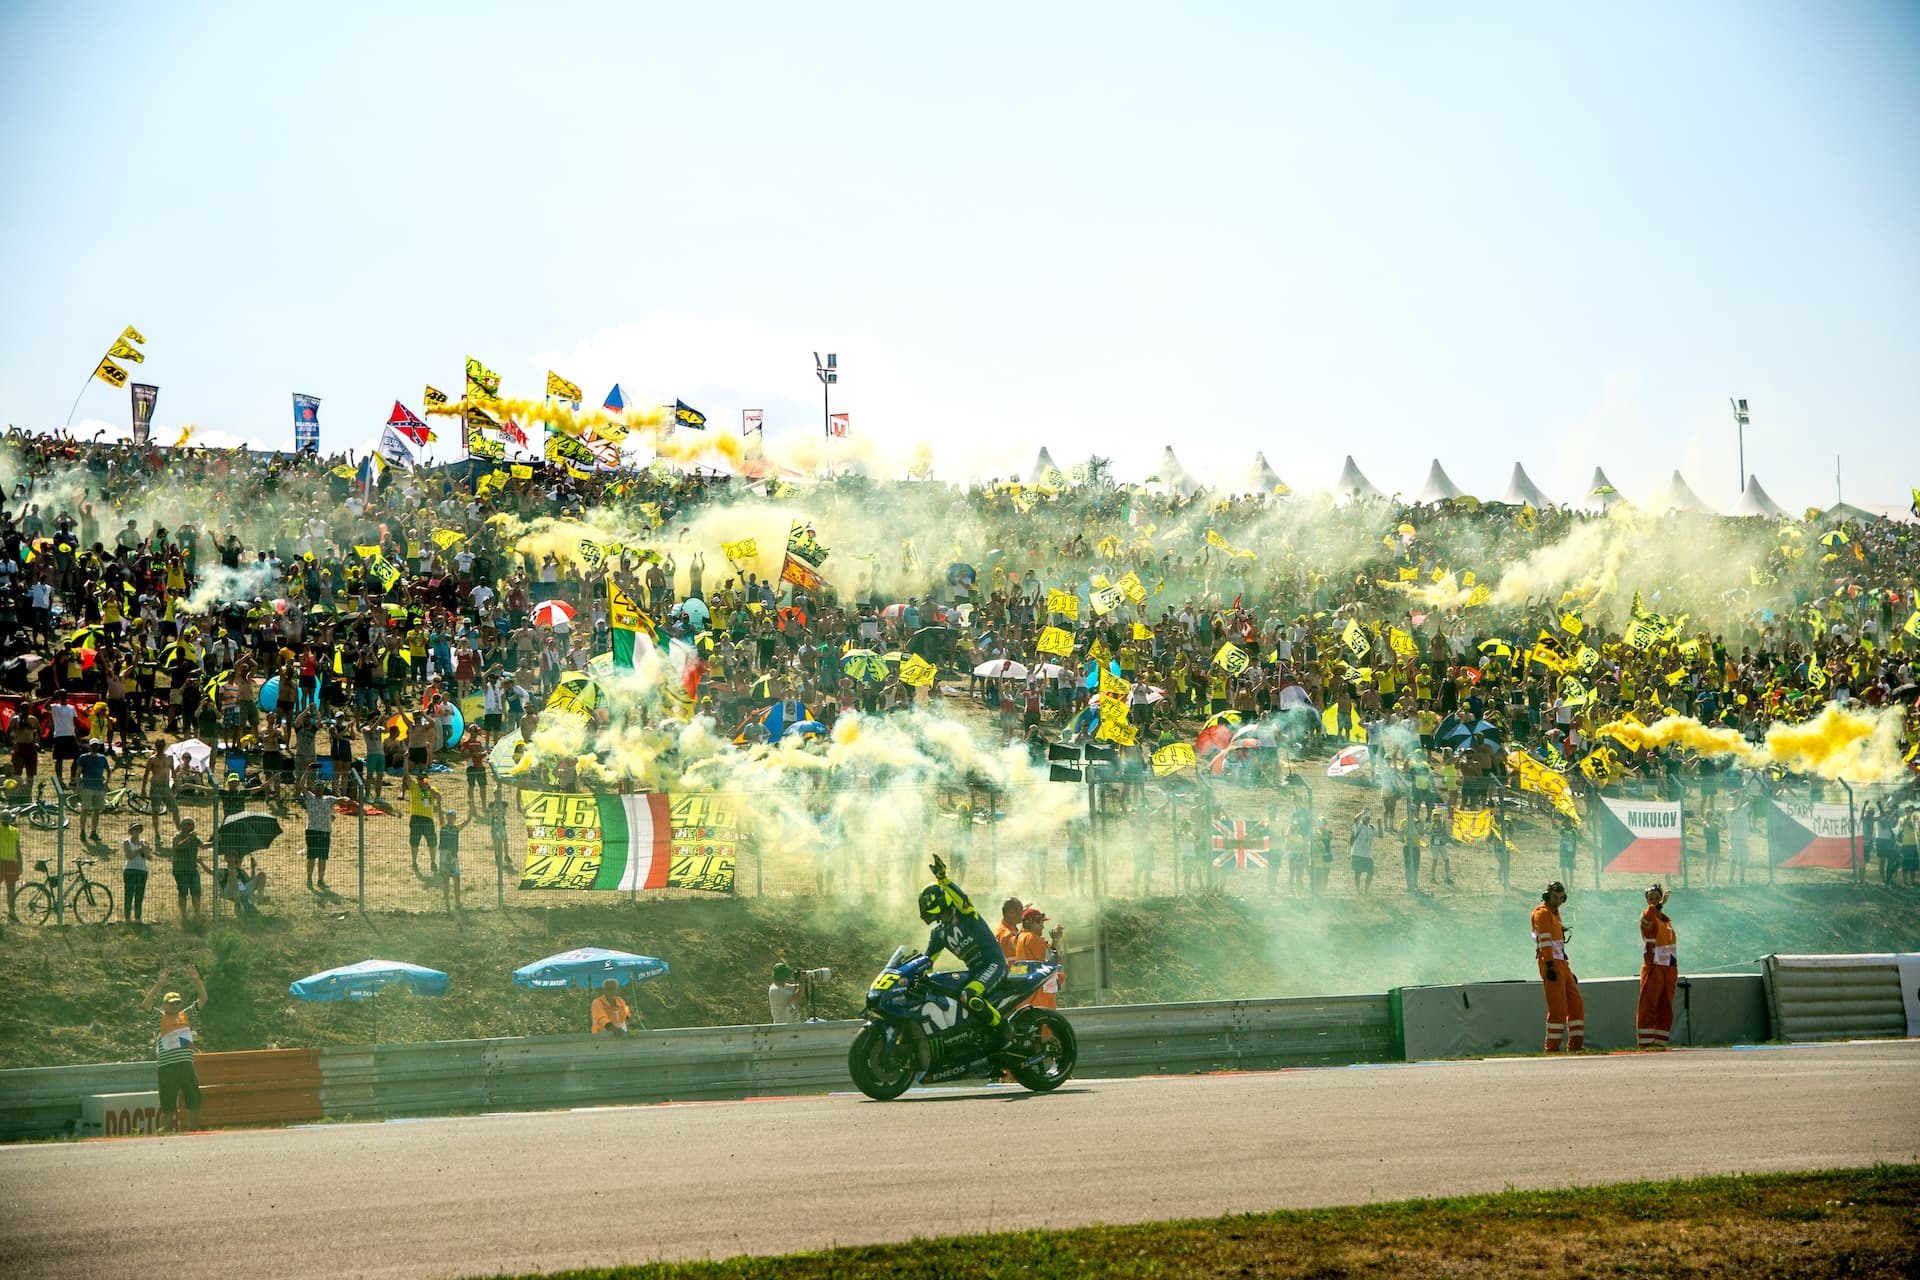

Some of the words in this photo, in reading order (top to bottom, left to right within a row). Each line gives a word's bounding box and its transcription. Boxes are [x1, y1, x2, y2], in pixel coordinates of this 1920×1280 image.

[1047, 594, 1078, 613] 46
[1036, 631, 1076, 652] 46
[524, 794, 598, 828] 46
[671, 795, 738, 828] 46
[1627, 810, 1678, 828] MIKULOV
[932, 1064, 966, 1081] ENEOS
